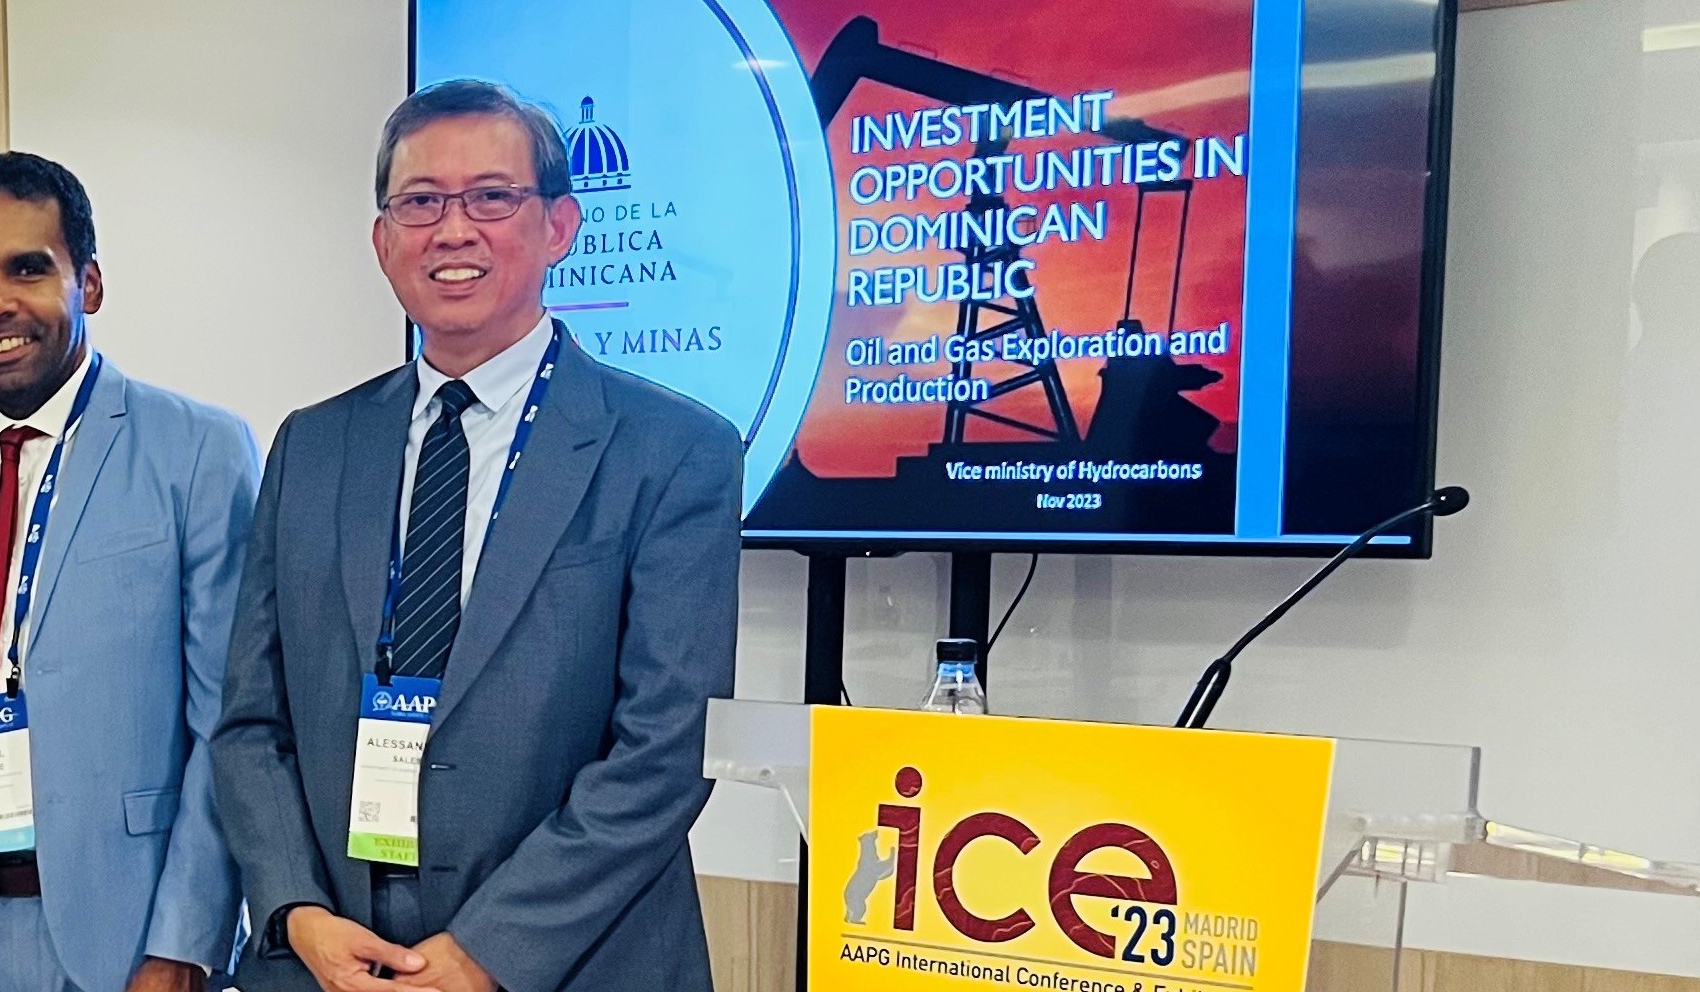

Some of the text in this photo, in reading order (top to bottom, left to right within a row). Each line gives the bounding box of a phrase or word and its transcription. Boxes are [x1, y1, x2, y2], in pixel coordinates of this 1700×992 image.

[851, 90, 1115, 154] INVESTMENT
[849, 134, 1246, 203] OPPORTUNITIES IN
[615, 203, 640, 221] DE
[651, 201, 677, 218] LA
[849, 200, 1106, 256] DOMINICAN
[570, 229, 663, 256] BLICA
[848, 260, 1036, 306] REPUBLIC
[595, 326, 722, 355] Y MINAS
[846, 322, 1229, 367] Oil and Gas Exploration and
[845, 374, 988, 405] Production
[946, 461, 1203, 482] Vice ministry of Hydrocarbons
[1036, 493, 1102, 509] Nov 2023
[391, 694, 437, 713] AAP
[367, 737, 423, 751] ALESSAN
[877, 766, 1178, 958] ice
[1111, 905, 1176, 966] '23
[1184, 912, 1258, 941] MADRID
[840, 943, 890, 966] AAPG
[896, 951, 1011, 982] International
[1182, 940, 1256, 977] SPAIN
